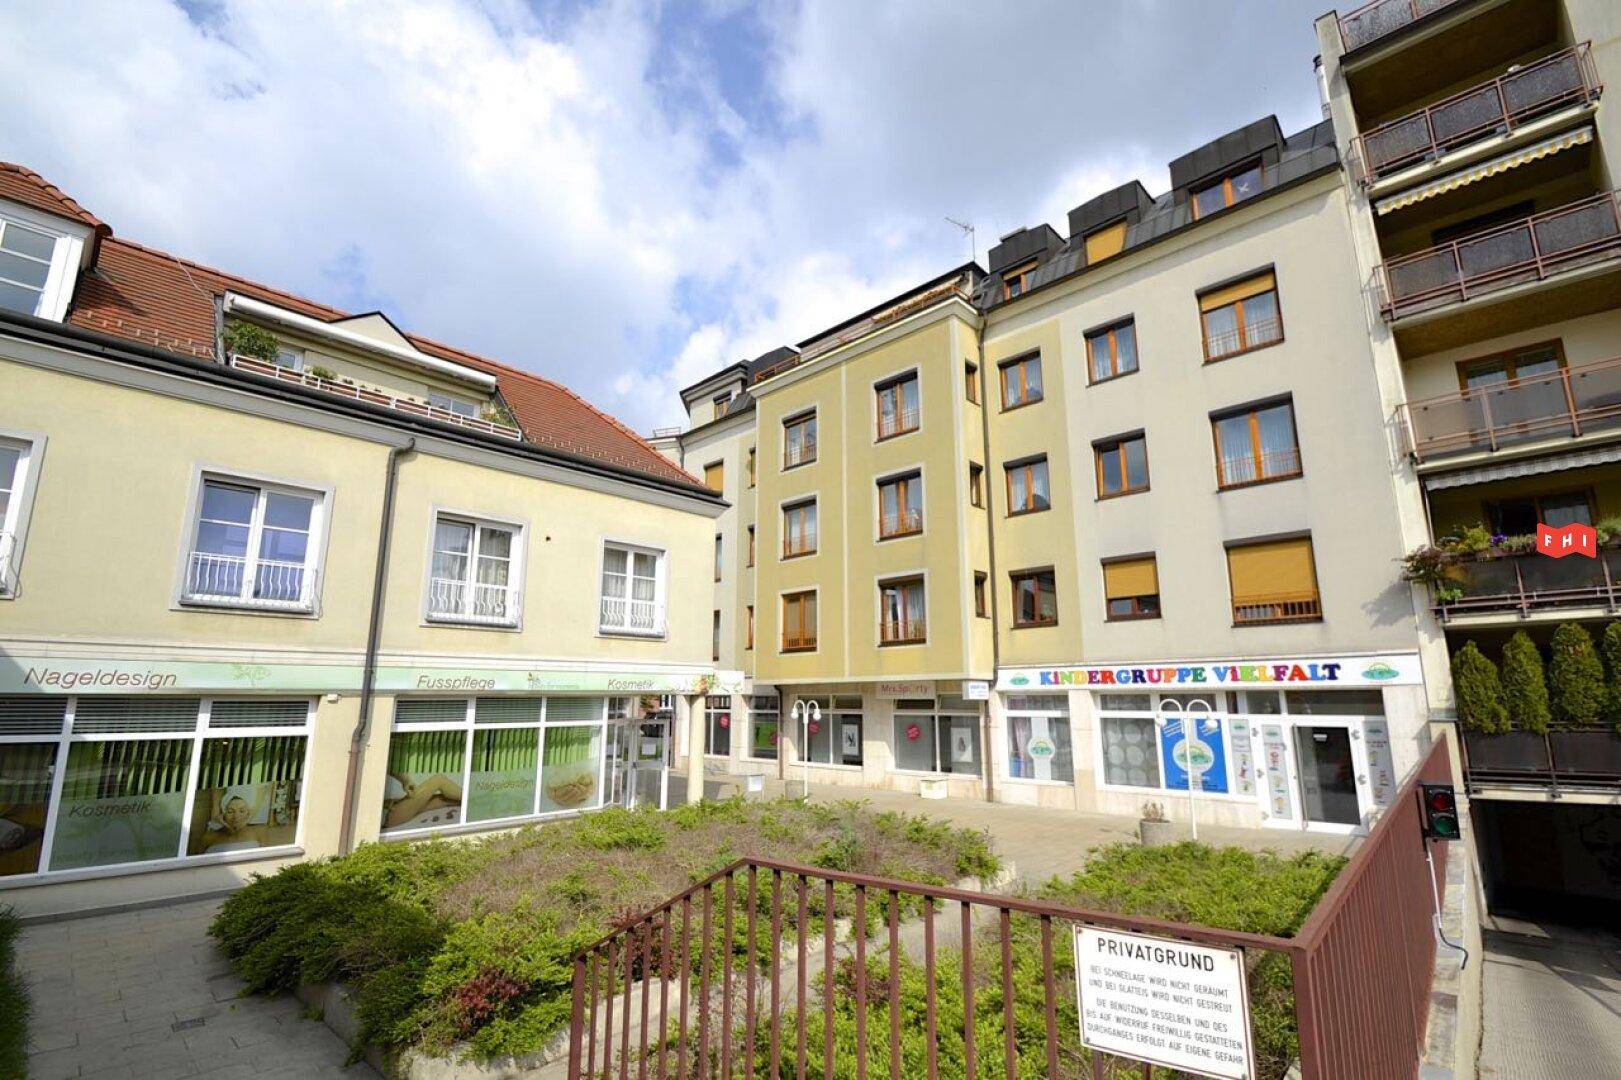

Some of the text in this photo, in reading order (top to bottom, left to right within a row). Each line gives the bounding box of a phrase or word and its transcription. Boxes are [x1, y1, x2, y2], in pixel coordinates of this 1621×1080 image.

[24, 667, 177, 690] Nageldesign
[417, 675, 496, 691] Fusspflege
[607, 678, 655, 690] Kosmetik
[69, 800, 152, 818] Kosmetik
[1097, 937, 1214, 972] PRIVATGRUND
[1104, 967, 1145, 984] SCHNEELAGE
[1149, 976, 1167, 987] WIRD
[1170, 980, 1190, 991] NICHT
[1089, 979, 1102, 988] UND
[1105, 982, 1116, 991] BEI
[1151, 990, 1170, 1001] WIRD
[1172, 994, 1193, 1006] NICHT
[1196, 999, 1232, 1014] GESTREUT
[1086, 1008, 1097, 1019] BIS
[1100, 1011, 1112, 1021] AUF
[1115, 1015, 1149, 1029] WIDERRUF
[1194, 1032, 1243, 1050] GESTATTETEN
[1110, 1000, 1149, 1016] BENUTZUNG
[1151, 1009, 1191, 1025] DESSELBEN
[1194, 1018, 1210, 1029] UND
[1213, 1022, 1228, 1033] DES
[1087, 1022, 1244, 1064] DURCHGANGES ERFOLGT AUF EIGENE GEFAHR
